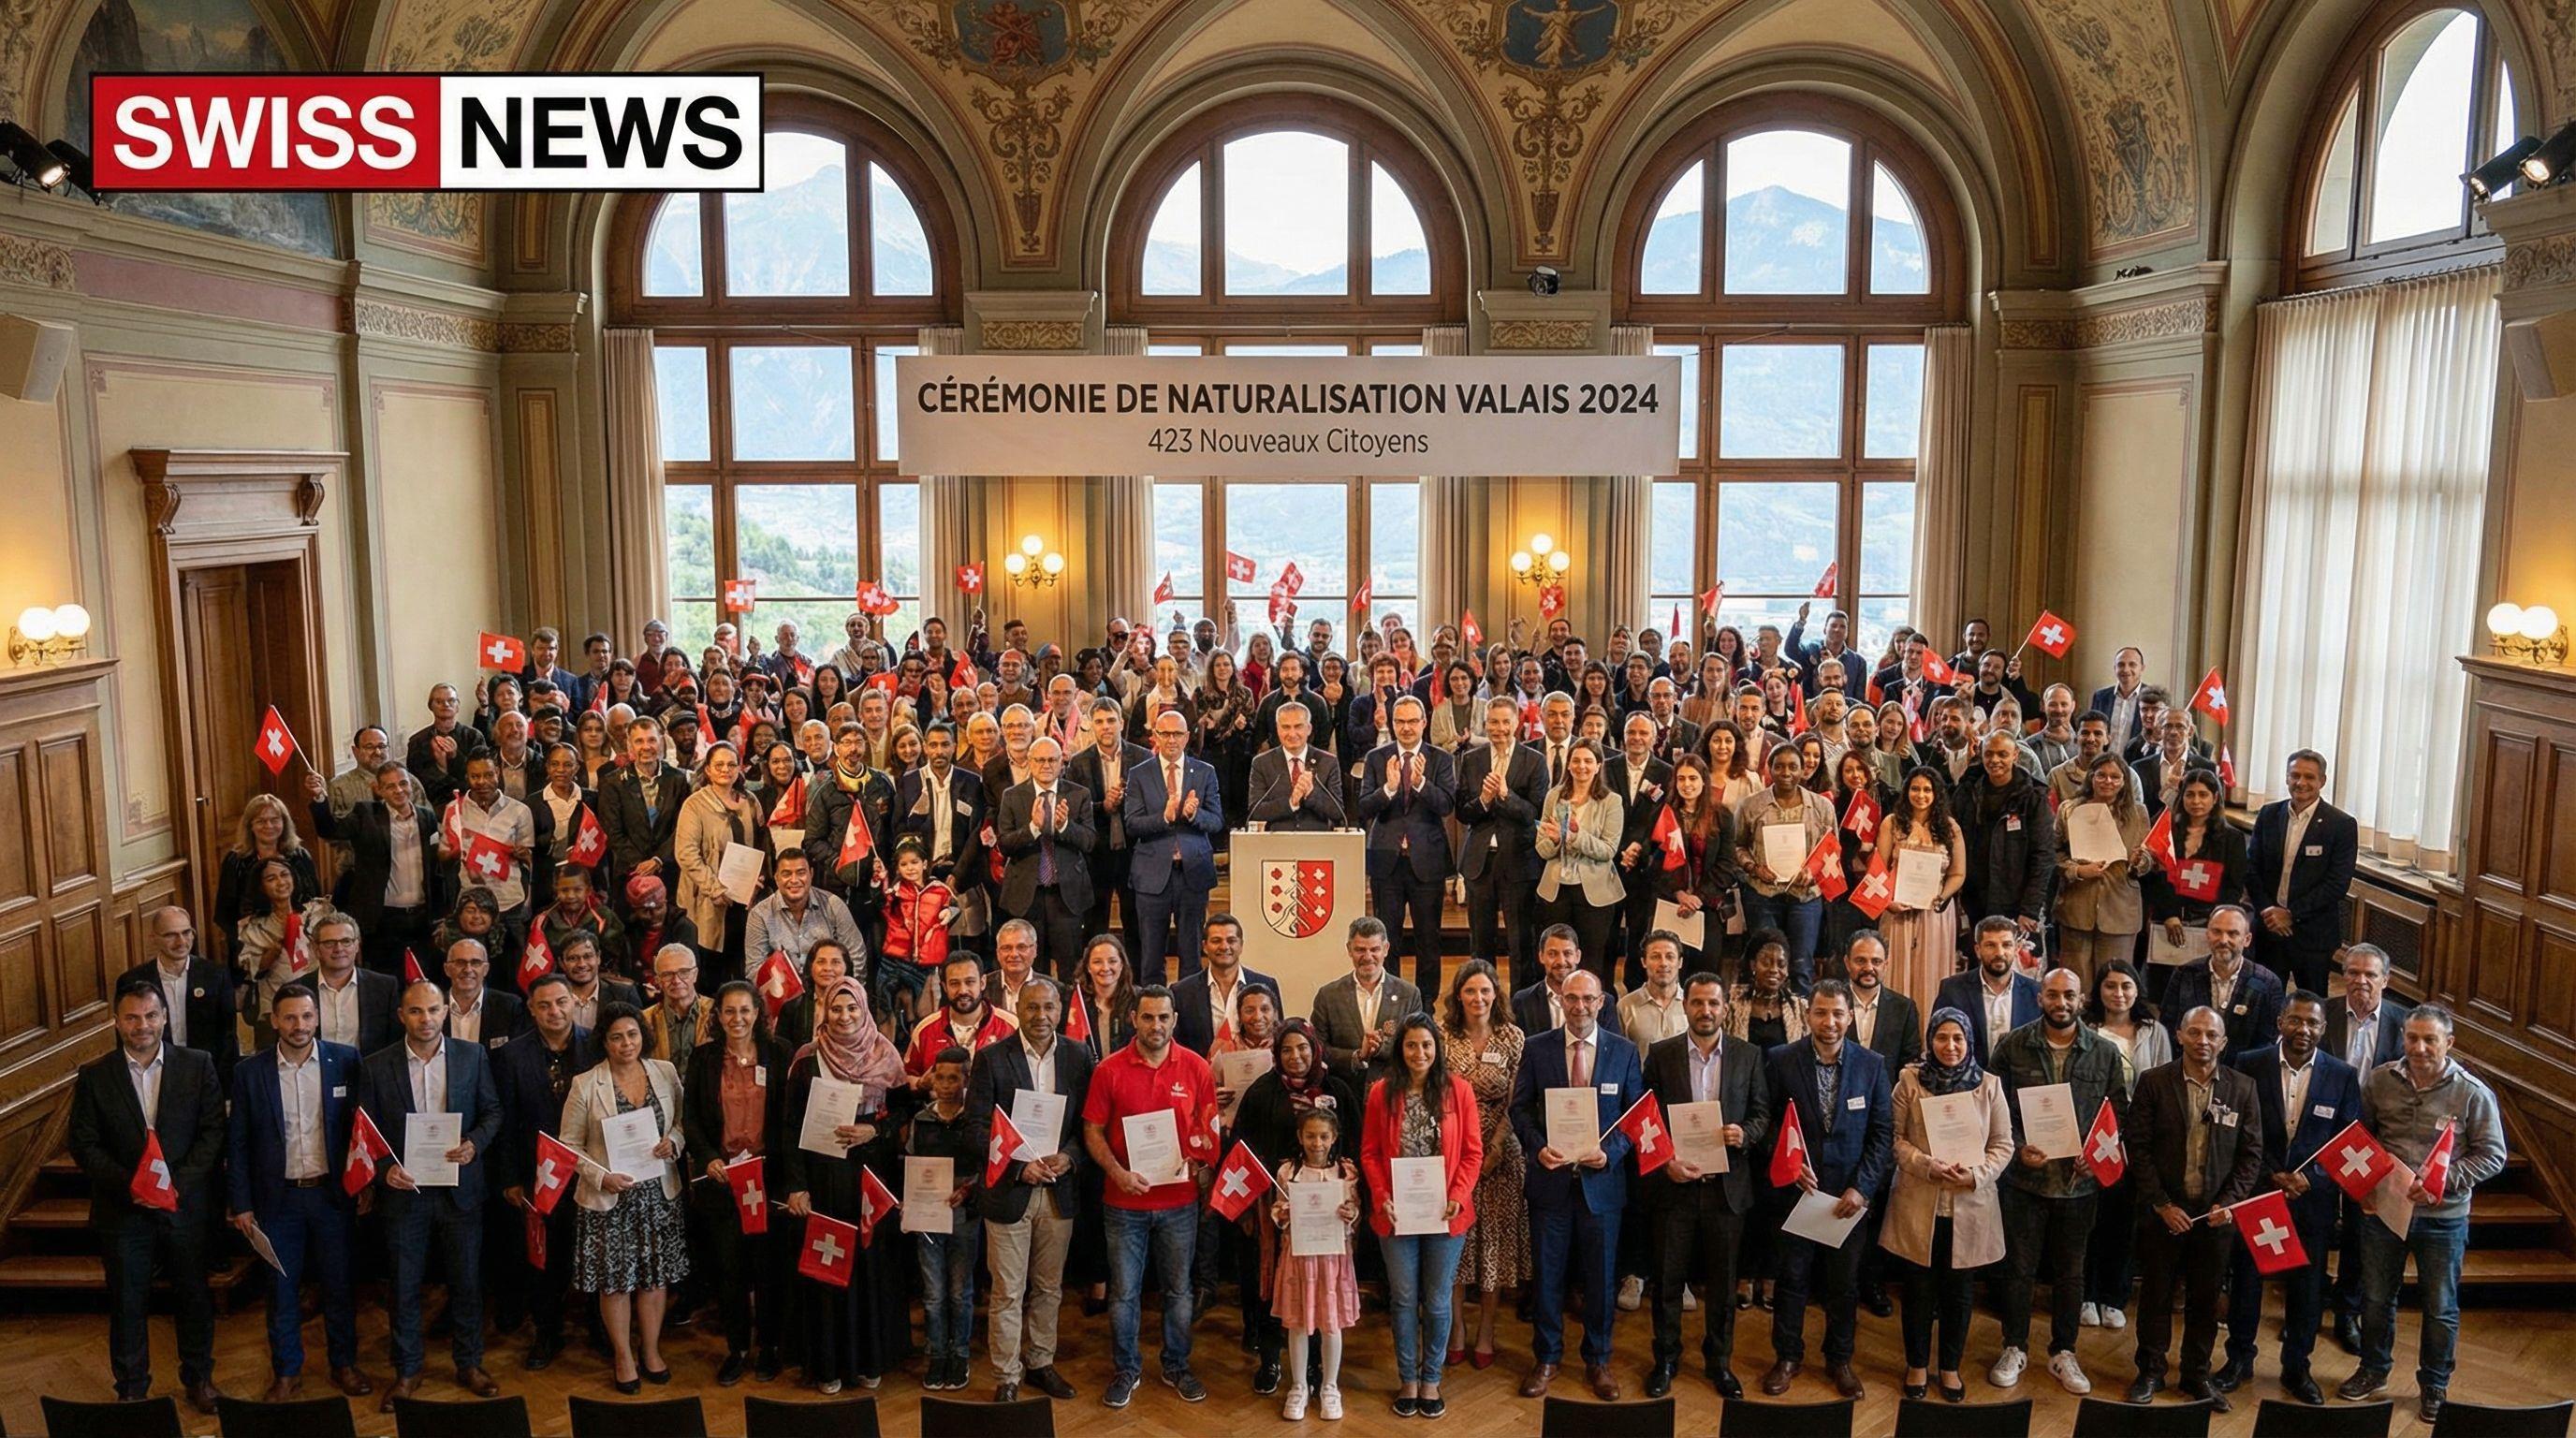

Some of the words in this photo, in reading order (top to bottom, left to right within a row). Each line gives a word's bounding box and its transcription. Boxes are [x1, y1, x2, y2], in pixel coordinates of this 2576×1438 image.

[918, 375, 1106, 414] CÉRÉMONIE
[1117, 383, 1159, 414] DE
[1167, 383, 1446, 415] NATURALISATION
[1455, 383, 1570, 415] VALAIS
[1578, 383, 1660, 415] 2024
[1148, 428, 1193, 454] 423
[1201, 428, 1320, 454] Nouveaux
[1326, 427, 1429, 459] Citoyens
